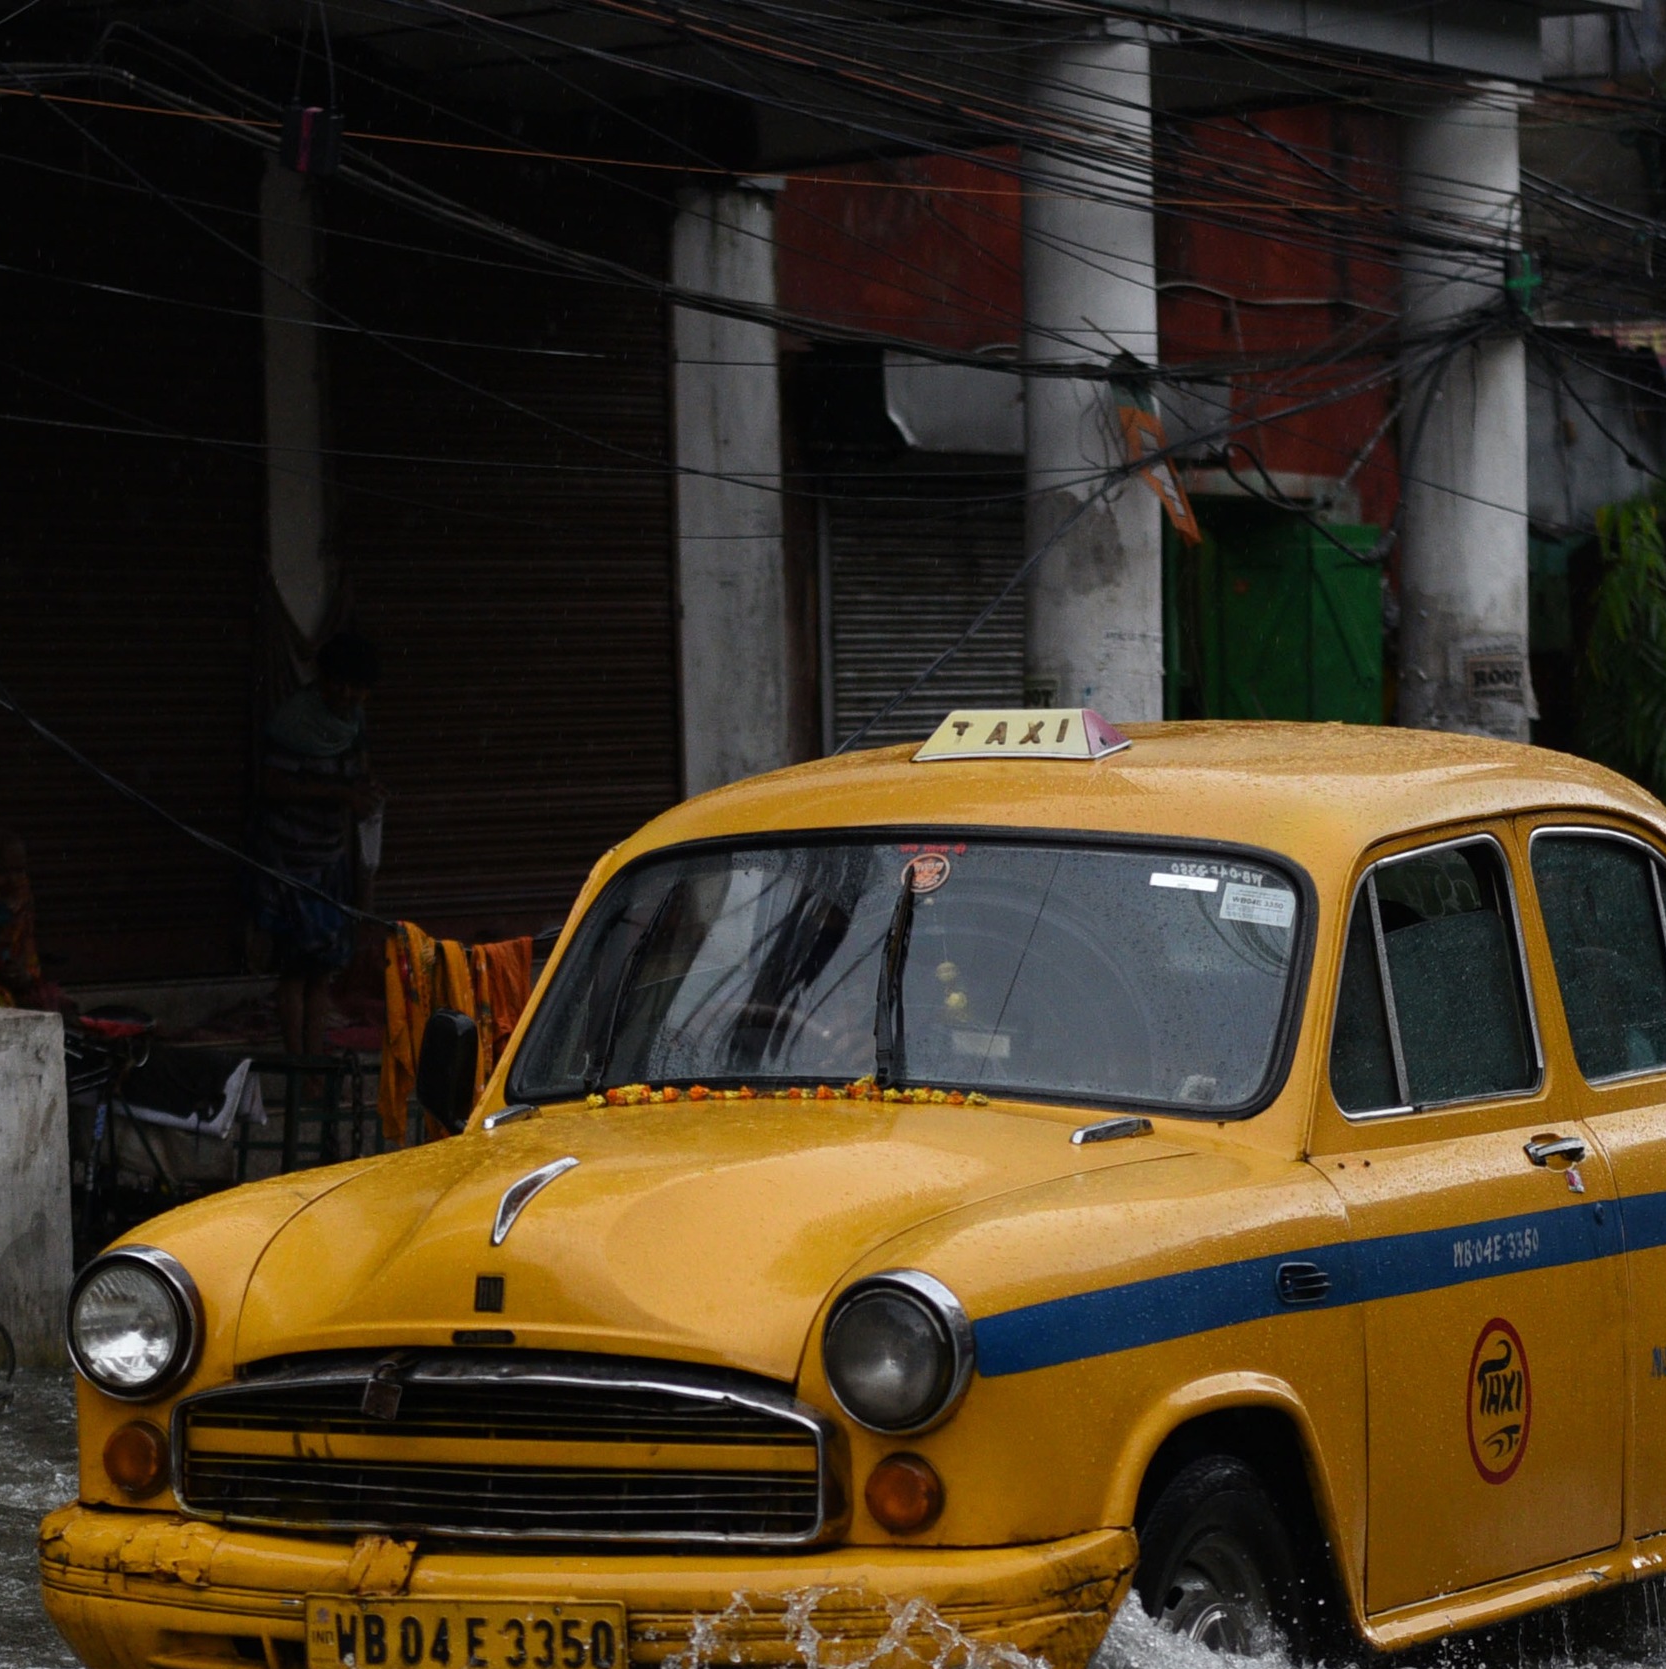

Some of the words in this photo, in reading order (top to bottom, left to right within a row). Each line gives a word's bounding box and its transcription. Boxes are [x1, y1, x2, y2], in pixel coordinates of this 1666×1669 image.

[952, 718, 1070, 745] TAXI
[1478, 1339, 1523, 1416] TAXI
[336, 1613, 385, 1664] WB
[401, 1616, 449, 1665] 04
[466, 1618, 487, 1667] E
[505, 1619, 614, 1669] 3350
